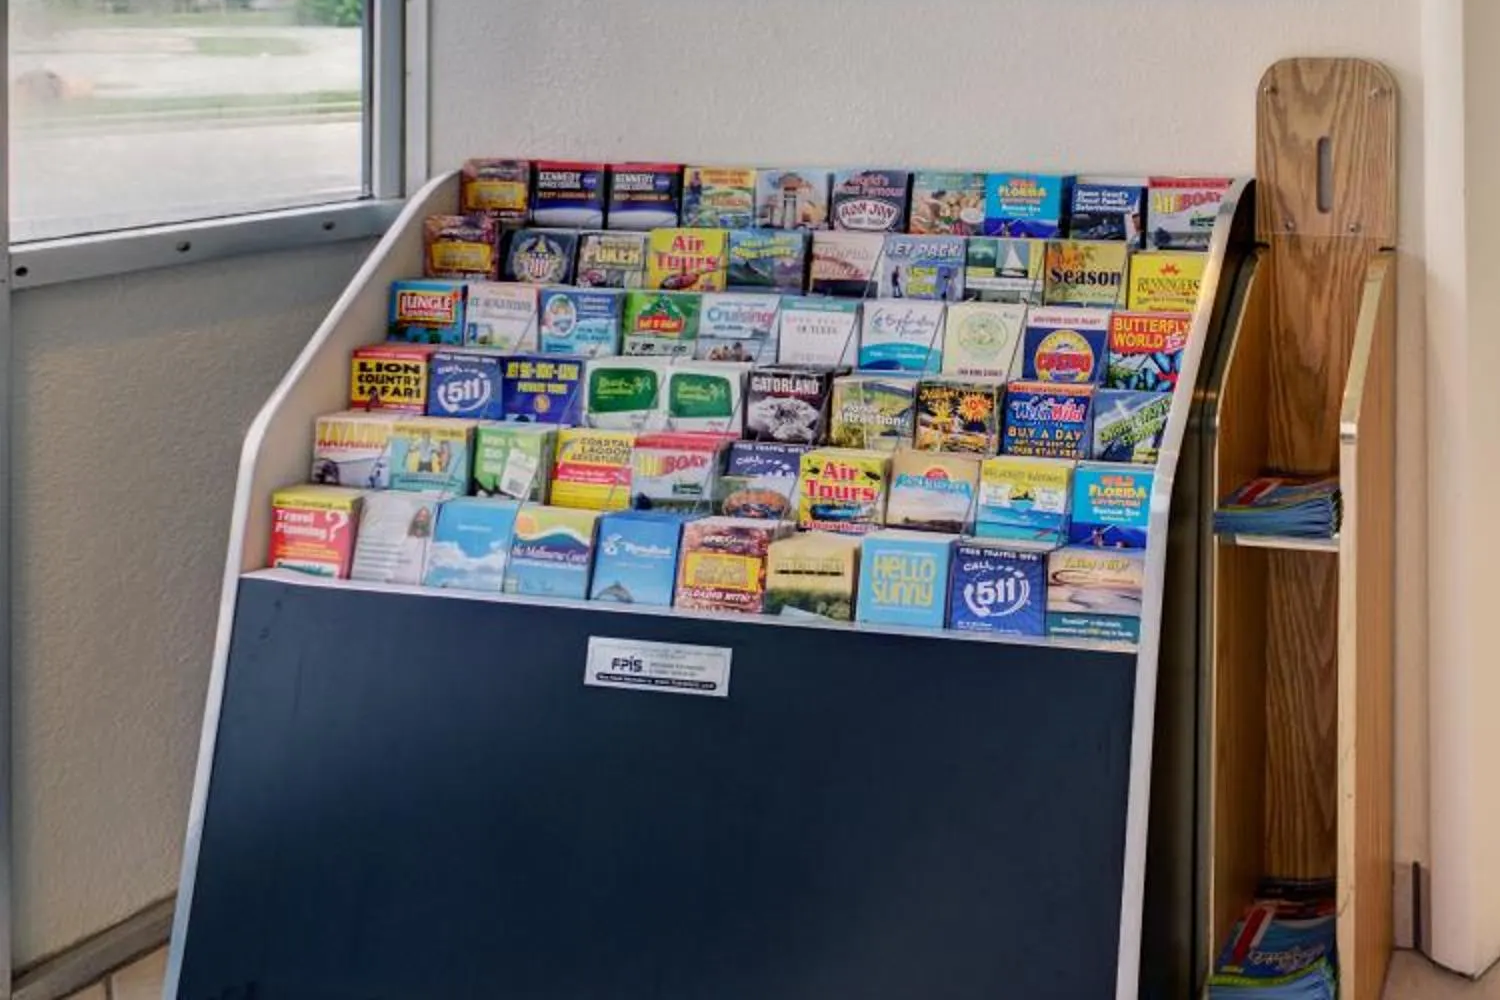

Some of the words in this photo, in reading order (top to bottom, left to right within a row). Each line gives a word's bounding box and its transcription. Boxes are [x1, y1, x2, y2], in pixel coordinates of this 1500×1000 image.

[672, 235, 704, 250] Air
[656, 255, 718, 272] Tours
[707, 306, 773, 327] Cruising
[1113, 318, 1192, 334] BUTTERFLY
[1113, 332, 1163, 348] WORLD
[358, 361, 421, 374] LION
[357, 373, 421, 387] COUNTRY
[751, 376, 820, 395] GATORLAND
[357, 386, 421, 399] SAFARI
[449, 378, 480, 401] 511
[1008, 426, 1034, 438] BUY
[1055, 429, 1082, 441] DAY
[822, 461, 860, 481] Air
[804, 479, 876, 501] Tours
[976, 577, 1016, 605] 511
